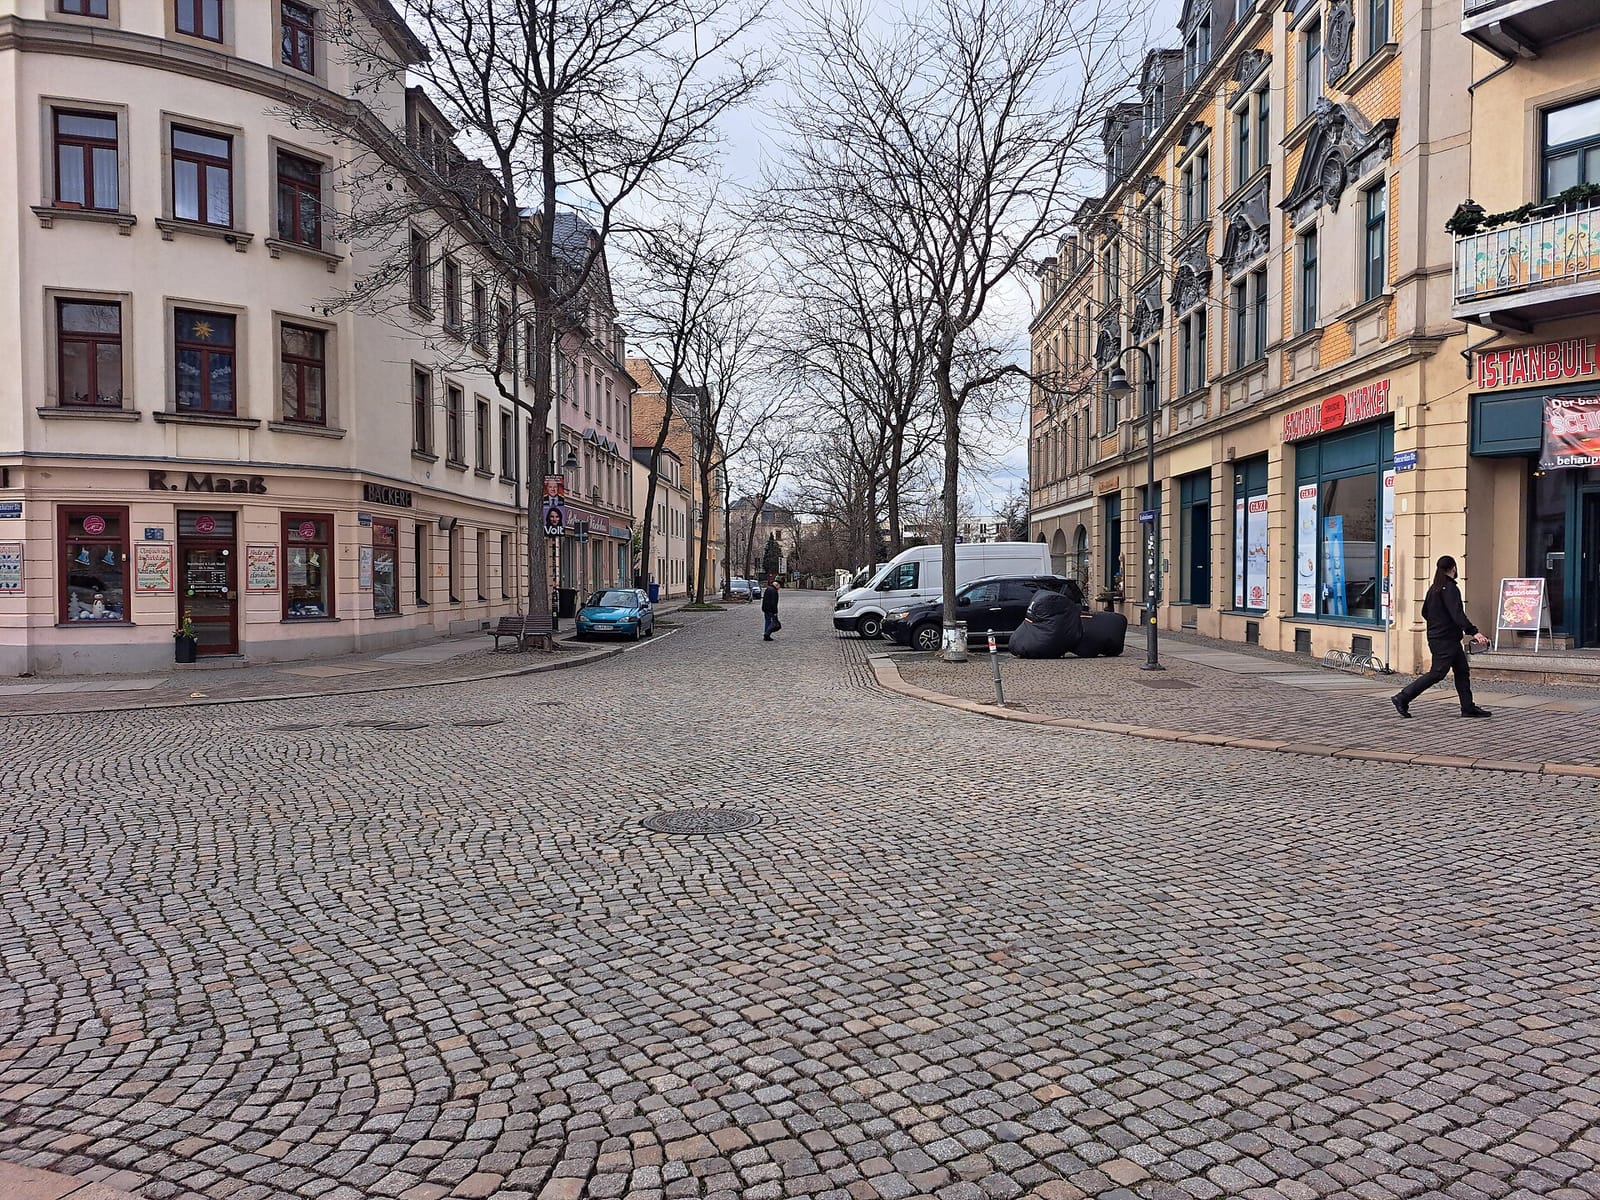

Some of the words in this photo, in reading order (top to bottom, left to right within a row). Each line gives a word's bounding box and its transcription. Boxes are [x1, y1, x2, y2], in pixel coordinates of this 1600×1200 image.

[1476, 338, 1593, 389] ISTANBUL
[1283, 405, 1321, 441] ISTANBUL
[1346, 379, 1390, 425] MARKET
[1552, 399, 1574, 409] Der
[1557, 455, 1600, 466] behaup
[185, 472, 267, 494] Maaß
[1250, 500, 1266, 512] GAZI
[544, 525, 564, 535] Volt
